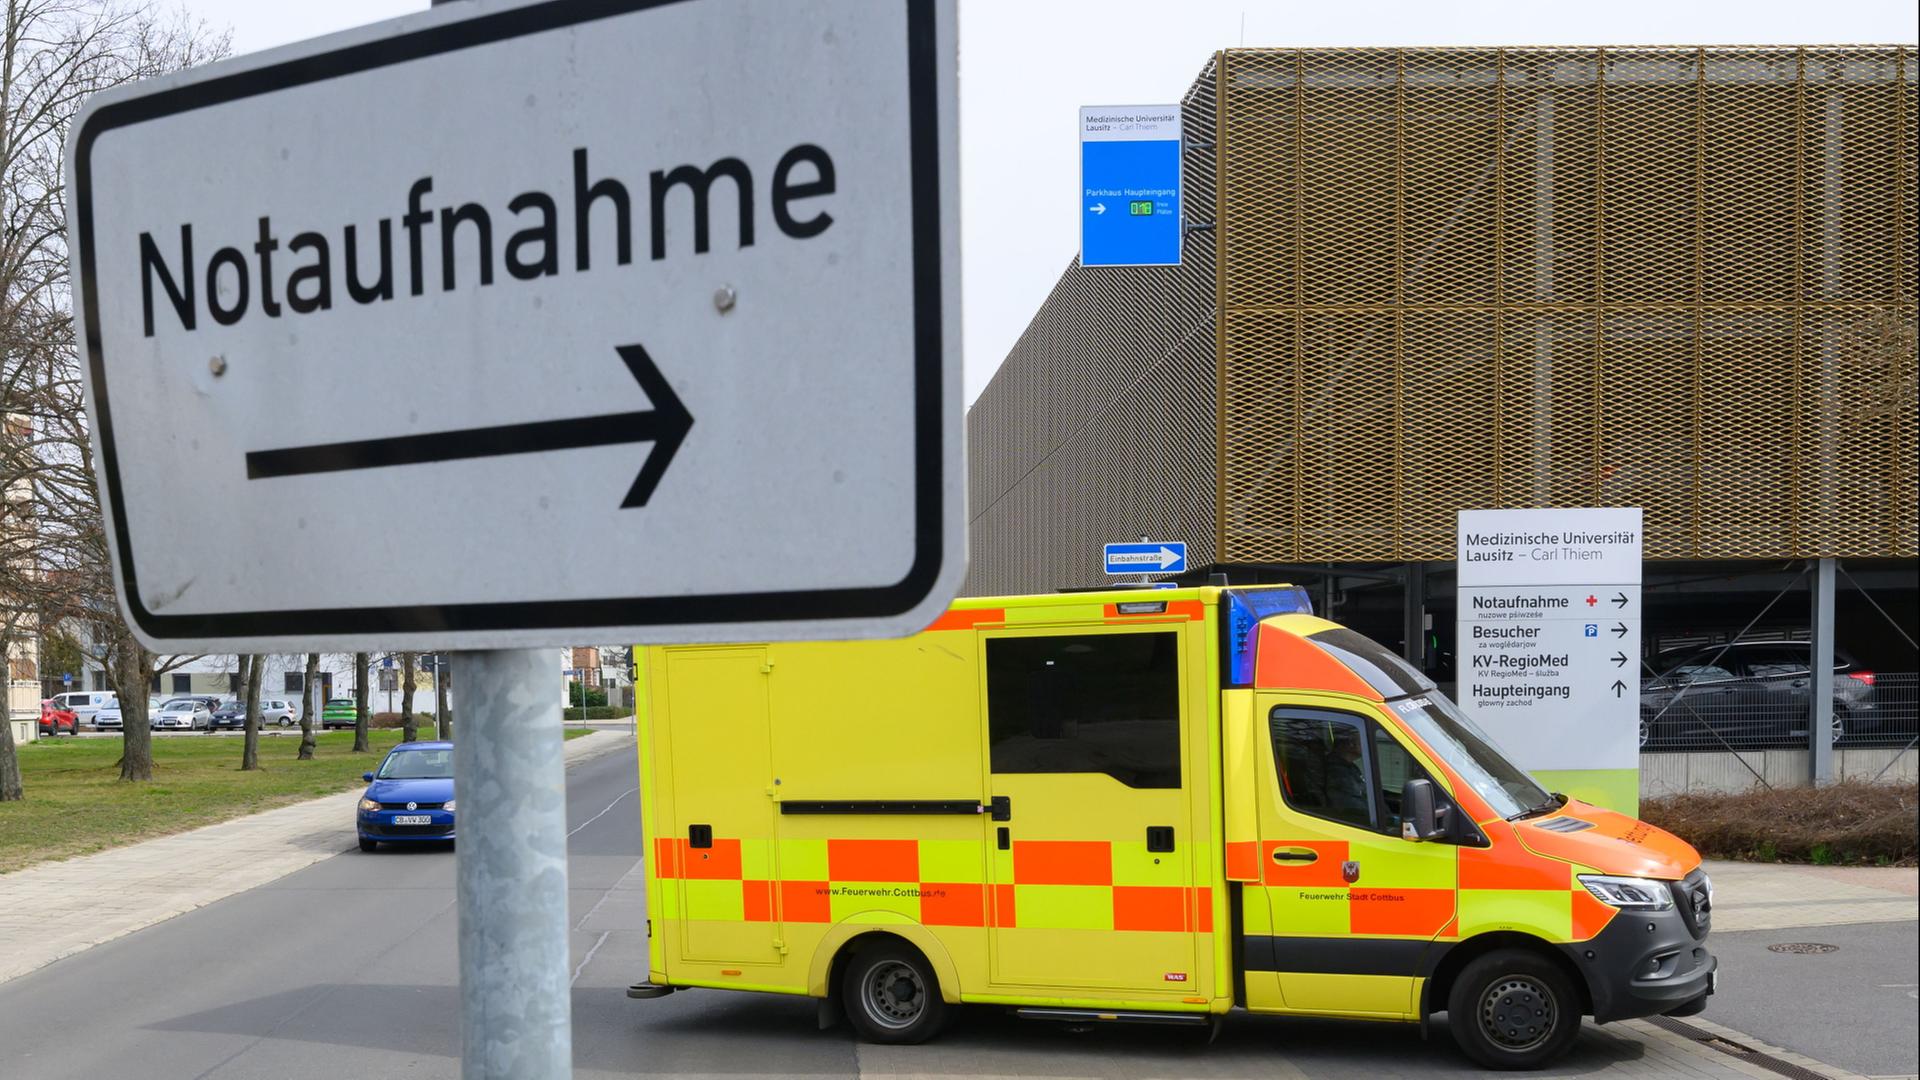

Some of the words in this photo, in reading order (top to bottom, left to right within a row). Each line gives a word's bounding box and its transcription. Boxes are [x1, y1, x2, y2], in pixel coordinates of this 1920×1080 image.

[1086, 115, 1134, 123] Medizinische
[1086, 124, 1111, 132] Lausitz
[1086, 189, 1122, 197] Parkhaus
[1124, 188, 1176, 198] Haupteingang
[139, 142, 836, 338] Notaufnahme
[1466, 533, 1559, 546] Medizinische
[1563, 531, 1634, 544] Universität
[1110, 554, 1163, 563] Einbahnstraße
[1466, 549, 1514, 562] Lausitz
[1531, 548, 1558, 561] Carl
[1562, 548, 1603, 560] Thiem
[1473, 595, 1569, 609] Notaufnahme
[1473, 625, 1541, 638] Besucher
[1473, 654, 1569, 670] KV-RegioMed
[1491, 670, 1528, 679] RegioMed
[1473, 683, 1570, 699] Haupteingang
[1299, 892, 1344, 900] Feuerwehr
[1346, 892, 1368, 901] Stadt
[1370, 893, 1405, 901] Cottbus
